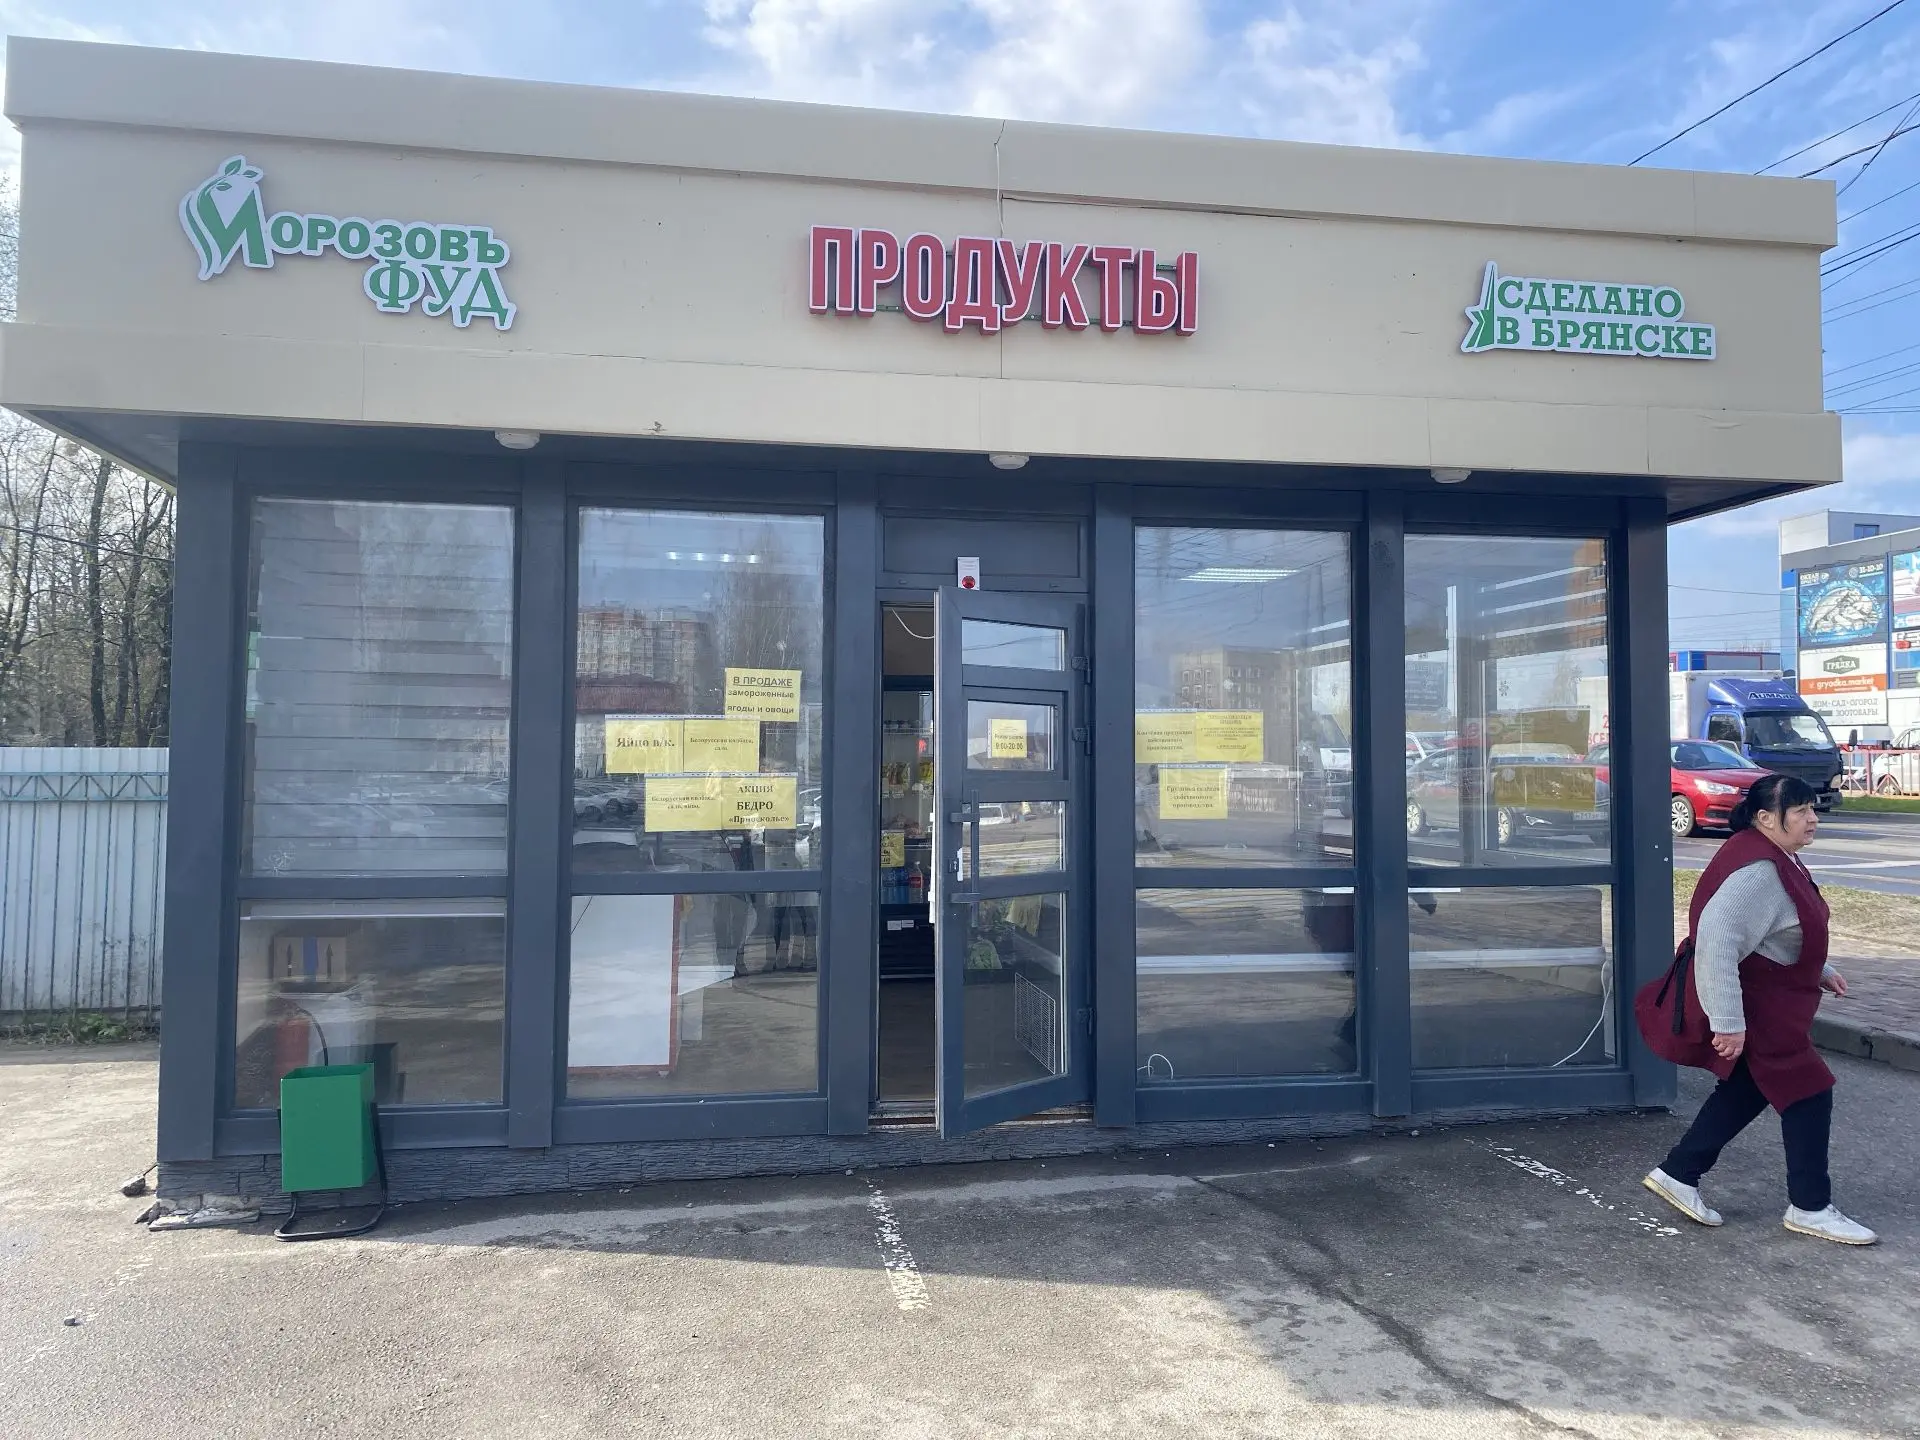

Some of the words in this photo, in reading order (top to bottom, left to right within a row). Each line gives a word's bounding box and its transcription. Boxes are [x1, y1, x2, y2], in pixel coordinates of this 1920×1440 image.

[809, 225, 1199, 334] ПРОДУКТЫ
[368, 260, 509, 327] ФУД
[1497, 279, 1682, 318] СДЕЛАНО
[1497, 316, 1520, 345] В
[1531, 318, 1712, 356] БРЯНСКЕ
[1826, 660, 1857, 670] ГРЯДКА
[733, 676, 740, 684] В
[743, 676, 793, 687] ПРОДАЖЕ
[728, 689, 795, 699] замороженные
[727, 705, 755, 713] ягоды
[616, 736, 650, 747] Яйцо
[737, 785, 774, 793] АКЦИЯ
[736, 801, 773, 812] БЕДРО
